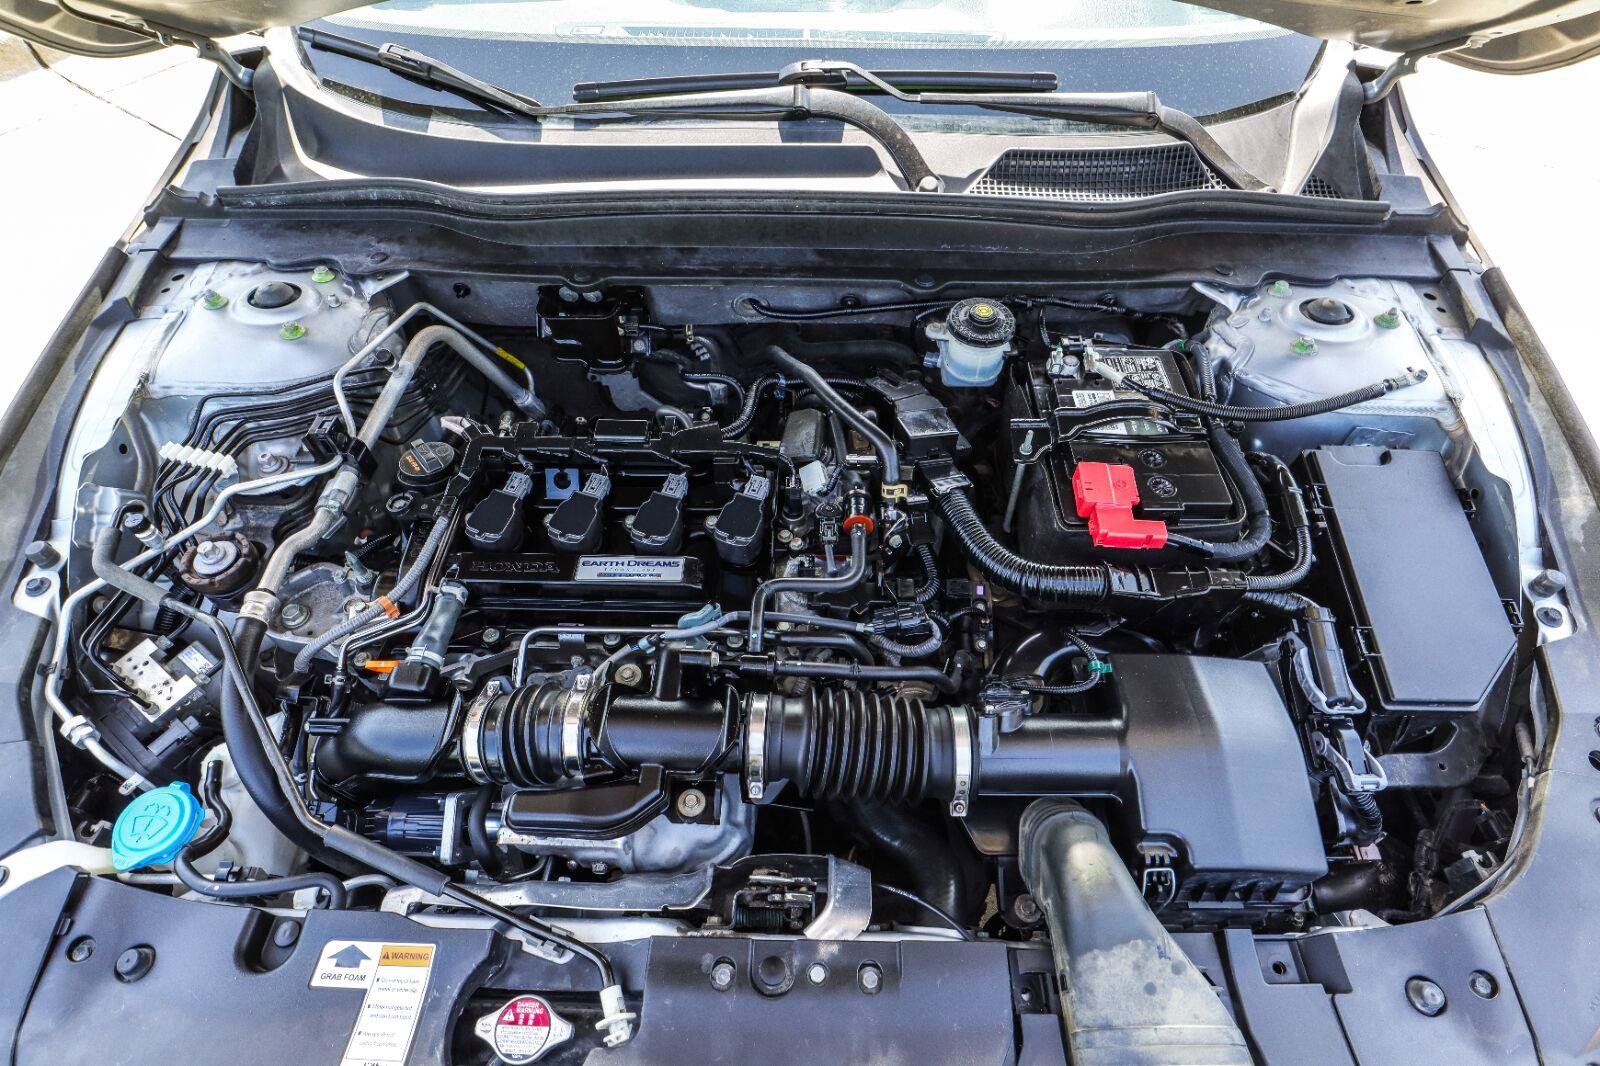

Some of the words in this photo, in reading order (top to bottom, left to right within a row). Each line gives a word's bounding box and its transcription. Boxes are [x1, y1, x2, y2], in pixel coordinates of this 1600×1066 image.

[471, 560, 561, 574] HONDA
[581, 560, 625, 568] EARTH
[627, 560, 680, 568] DREAMS
[390, 951, 430, 961] WARNING
[320, 972, 342, 981] GRAB
[343, 973, 367, 982] FOAM
